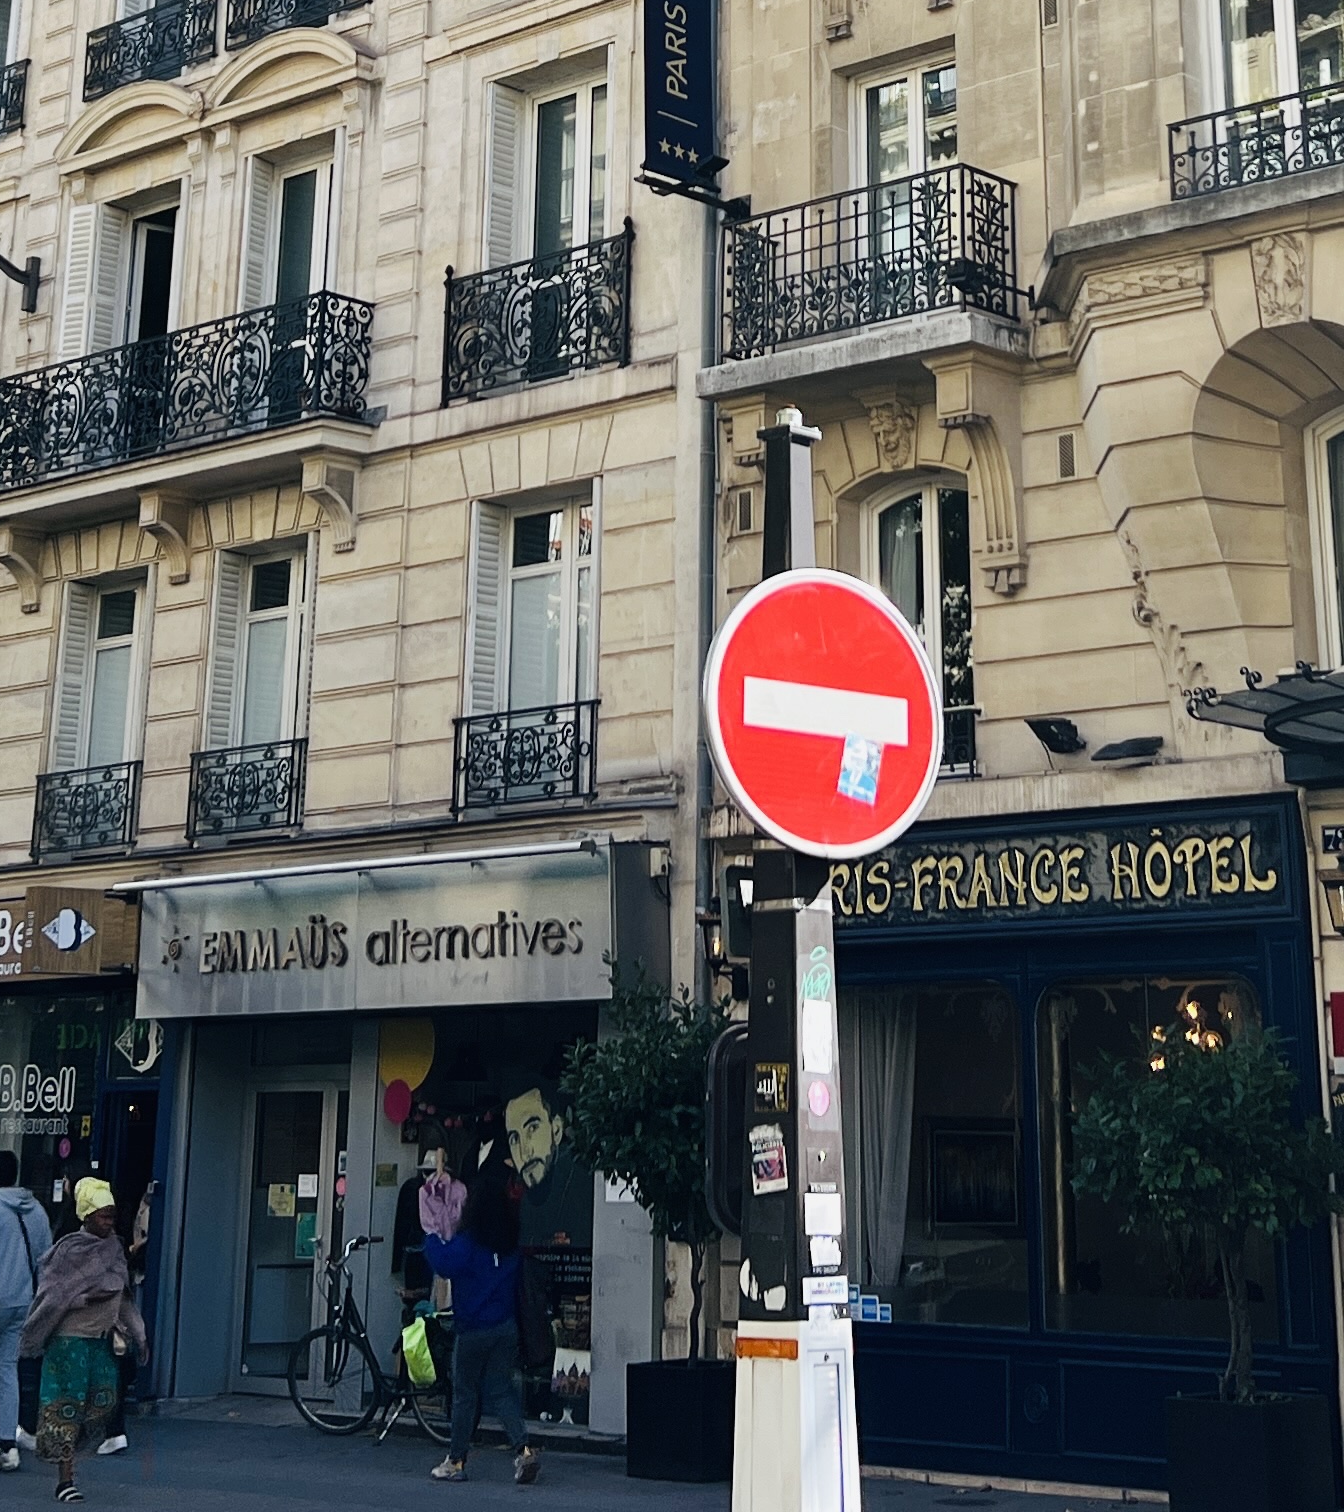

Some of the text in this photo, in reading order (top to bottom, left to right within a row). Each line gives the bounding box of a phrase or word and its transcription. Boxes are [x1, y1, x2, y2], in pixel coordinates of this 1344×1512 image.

[665, 3, 689, 101] PARIS
[830, 827, 1277, 918] RIS-FRANCE HÔTEL
[199, 910, 584, 975] EMMAÜS alternatives
